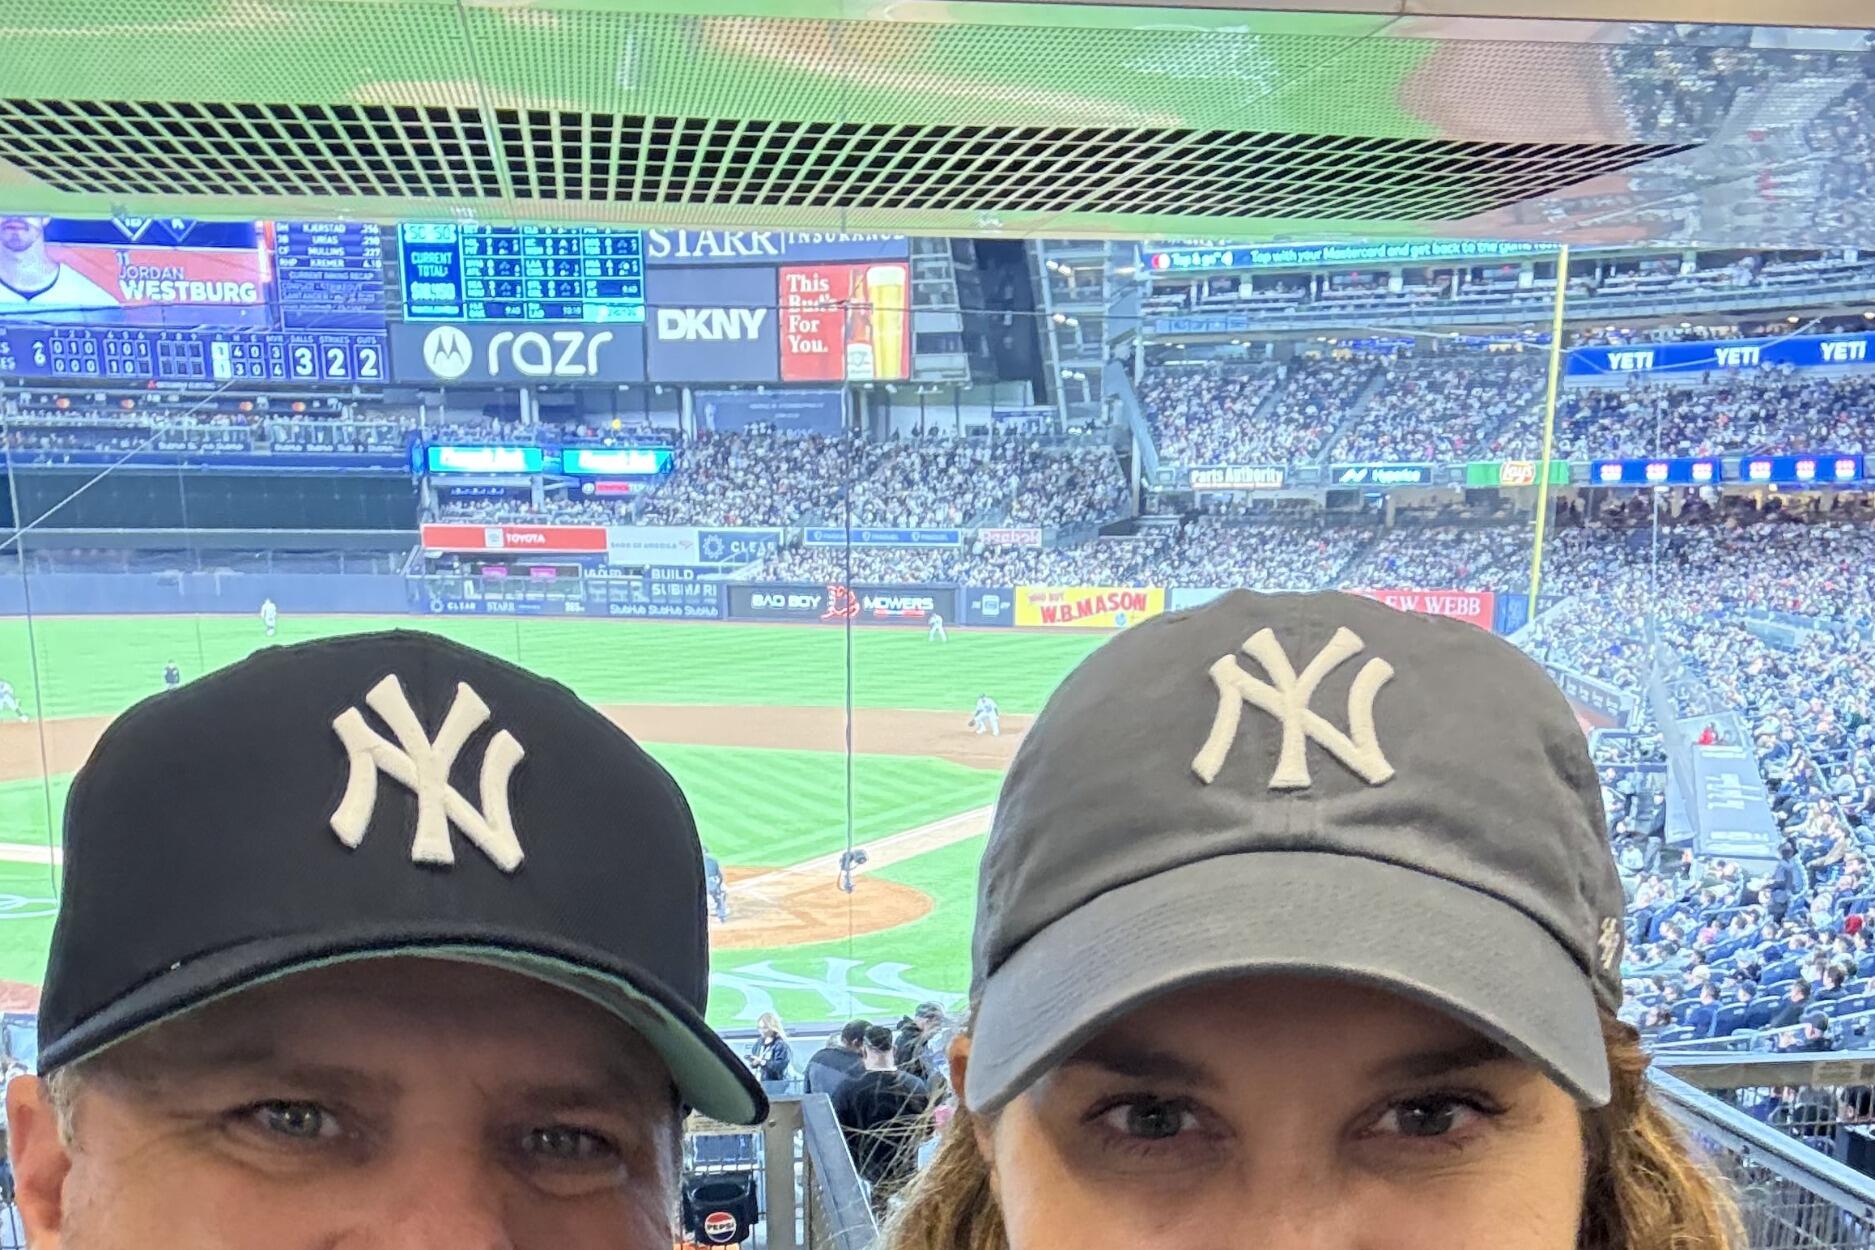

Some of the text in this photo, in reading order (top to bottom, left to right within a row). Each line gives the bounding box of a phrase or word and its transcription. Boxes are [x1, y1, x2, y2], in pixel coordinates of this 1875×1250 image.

[308, 247, 345, 257] MULLINS
[648, 229, 778, 257] STARR
[411, 252, 453, 264] CURRENT
[1250, 249, 1271, 264] Tap
[1272, 249, 1297, 262] with
[1298, 250, 1322, 263] your
[1323, 244, 1386, 260] Mastercard
[1387, 244, 1410, 257] and
[310, 259, 345, 268] KREMER
[119, 266, 184, 280] JORDAN
[119, 280, 257, 302] WESTBURG
[787, 273, 829, 293] This
[657, 308, 767, 340] DKNY
[789, 315, 820, 333] For
[53, 340, 62, 354] 0
[71, 342, 77, 354] 1
[85, 341, 94, 354] 0
[109, 342, 117, 354] 1
[123, 343, 132, 355] 0
[139, 343, 146, 355] 1
[234, 347, 242, 356] 4
[251, 346, 259, 357] 0
[272, 347, 281, 357] 3
[290, 335, 313, 343] BALLS
[319, 335, 349, 344] STRIKES
[357, 336, 377, 344] OUTS
[788, 335, 828, 353] You.
[34, 350, 46, 366] 6
[488, 331, 613, 376] razr
[1716, 347, 1760, 366] YETI
[1821, 341, 1867, 361] YETI
[55, 359, 64, 373] 0
[71, 359, 80, 372] 0
[86, 358, 95, 373] 0
[111, 359, 117, 372] 1
[125, 359, 134, 373] 0
[236, 363, 244, 375] 3
[252, 363, 261, 375] 0
[273, 364, 282, 375] 4
[295, 347, 313, 375] 3
[328, 348, 346, 376] 2
[359, 348, 378, 376] 2
[1608, 352, 1654, 370] YETI
[1191, 464, 1283, 485] Parts Authority
[506, 532, 545, 544] TOYOTA
[652, 569, 694, 580] BUILD
[447, 602, 476, 610] CLEAR
[610, 604, 646, 616] StubHub
[648, 604, 682, 616] StubHub
[684, 605, 718, 616] StubHub
[752, 595, 934, 610] BAD BOY MOWERS
[1424, 596, 1481, 616] WEBB
[1191, 626, 1396, 790] NY
[329, 673, 525, 873] NY
[706, 1221, 735, 1232] PEPSI
